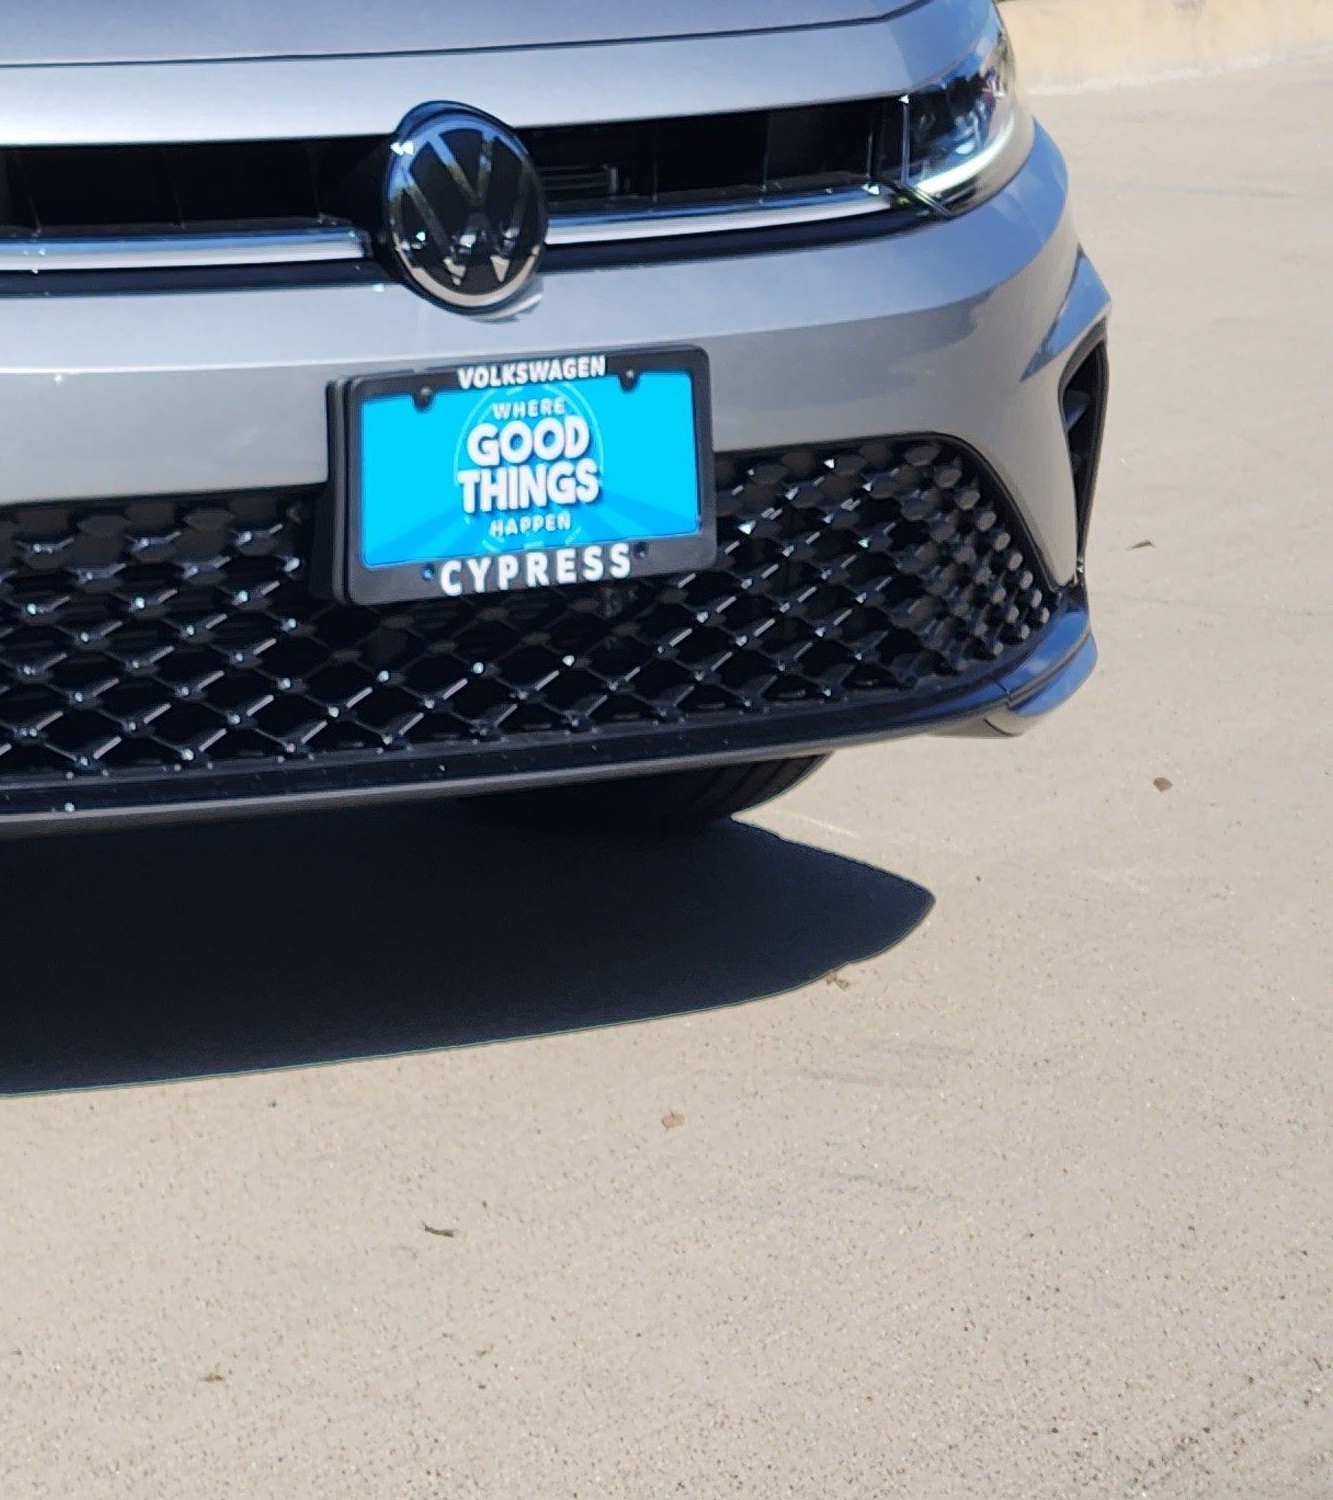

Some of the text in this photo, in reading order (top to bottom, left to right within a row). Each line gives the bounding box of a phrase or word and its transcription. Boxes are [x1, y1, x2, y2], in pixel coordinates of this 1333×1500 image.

[457, 355, 606, 389] VOLKSWAGEN
[492, 396, 565, 420] WHERE
[467, 415, 590, 466] GOOD
[457, 458, 599, 513] THINGS
[489, 511, 571, 537] HAPPEN
[440, 543, 630, 596] CYPRESS
